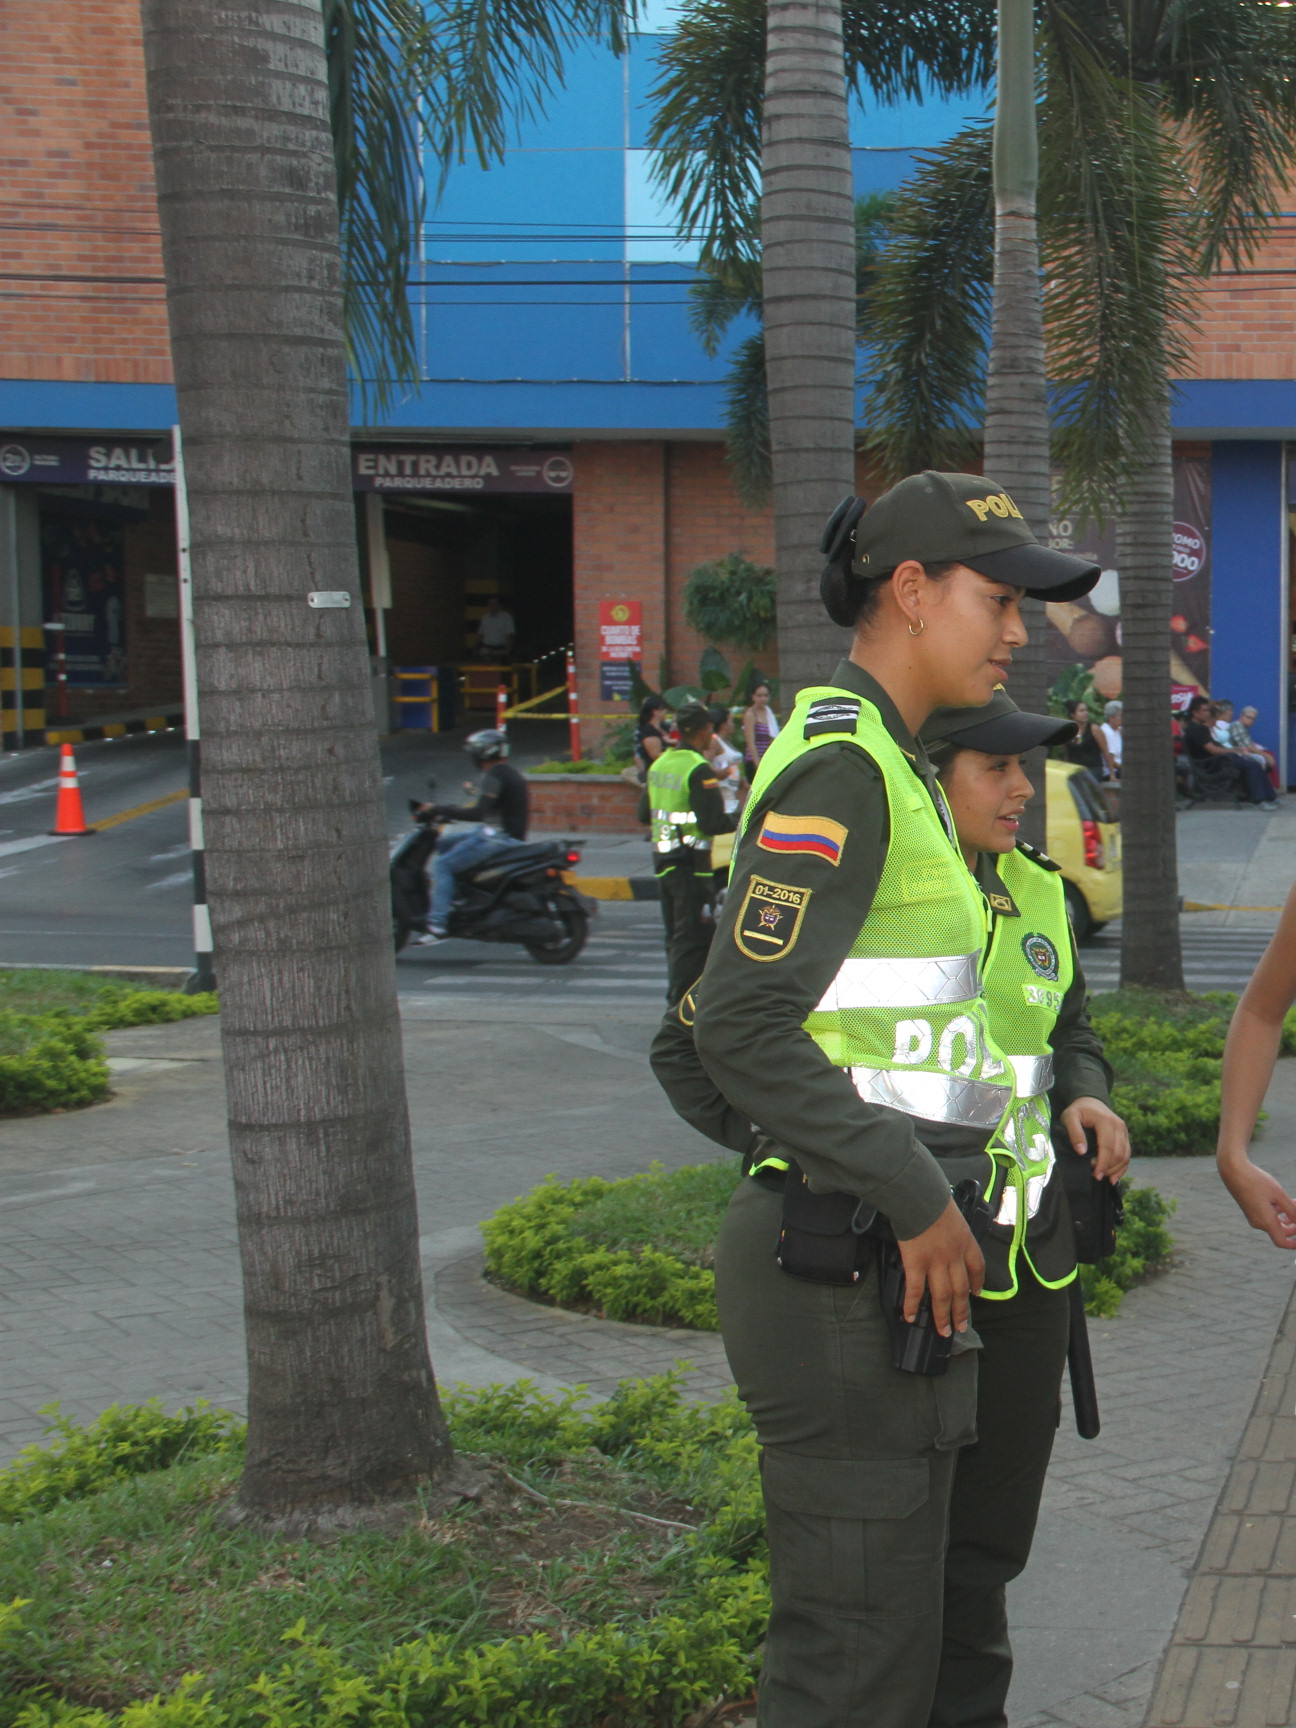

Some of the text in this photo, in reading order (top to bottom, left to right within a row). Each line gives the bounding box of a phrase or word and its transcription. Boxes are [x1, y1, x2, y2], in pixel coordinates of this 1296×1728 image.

[357, 454, 500, 476] ENTRADA
[374, 476, 485, 489] PARQUEADERO
[965, 493, 1024, 522] POL
[755, 884, 802, 904] 01-2016
